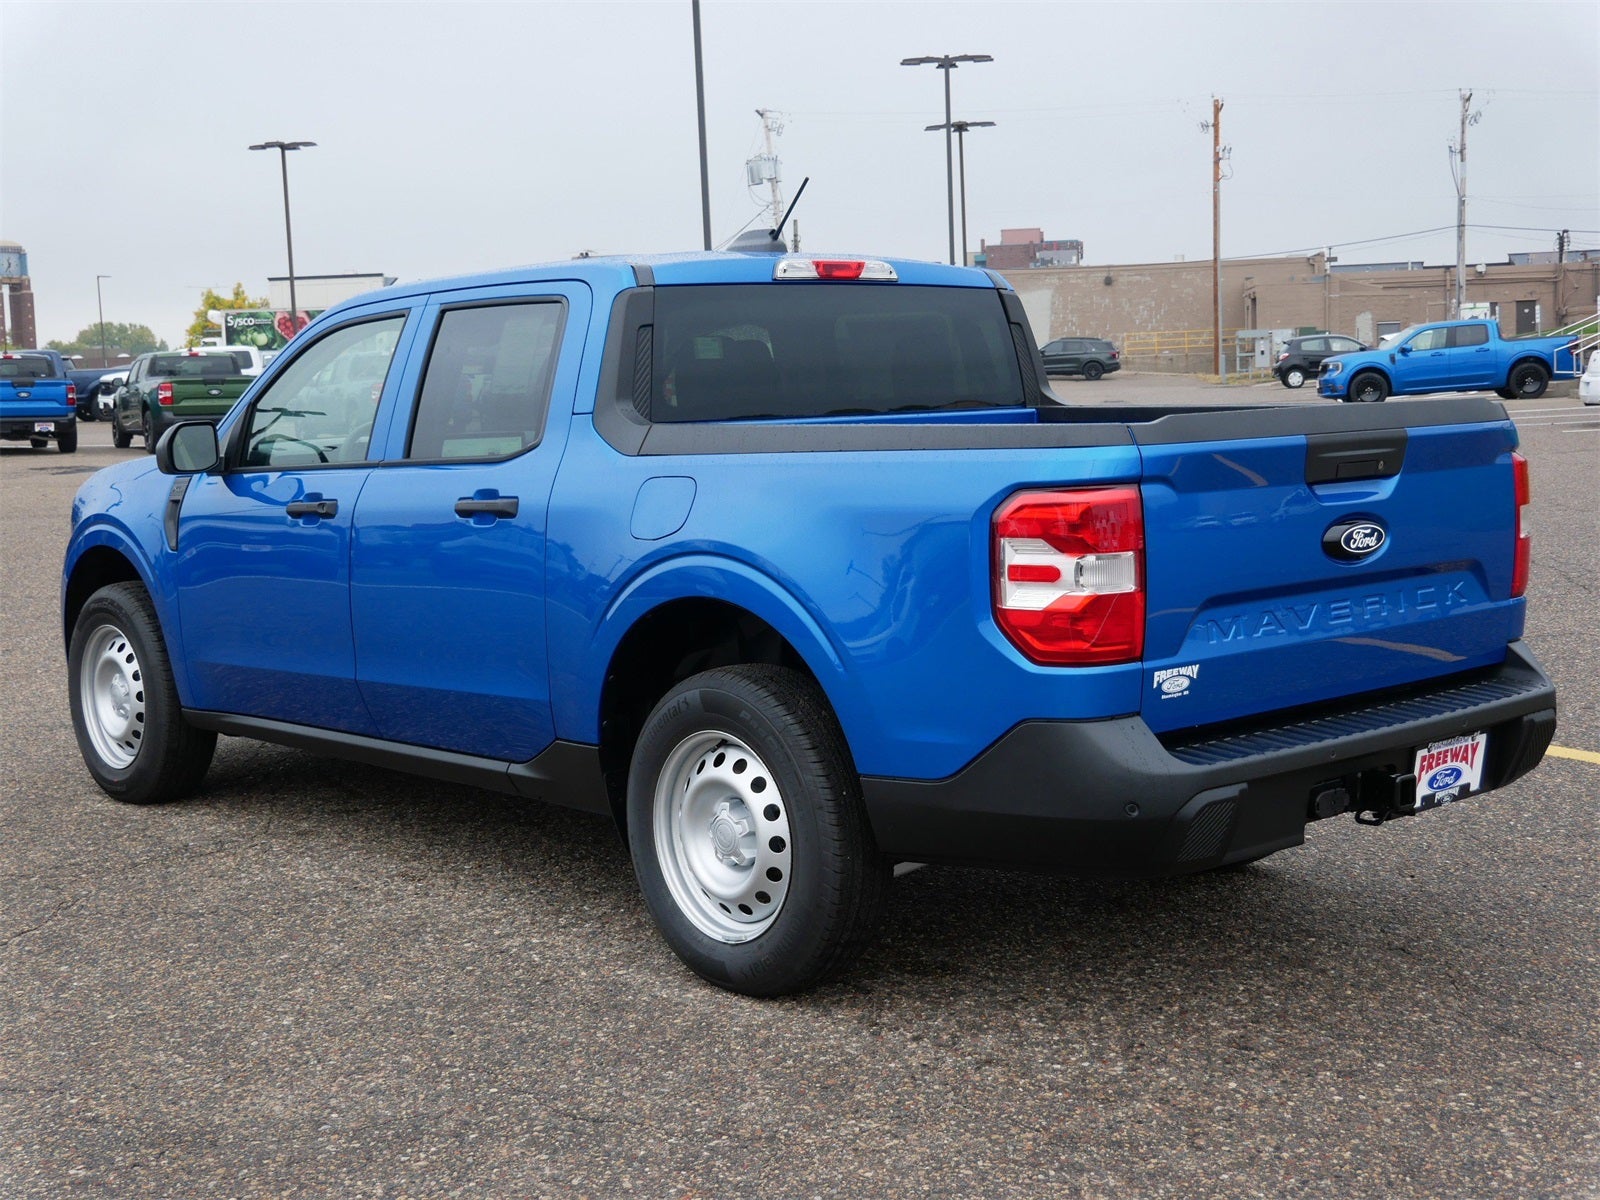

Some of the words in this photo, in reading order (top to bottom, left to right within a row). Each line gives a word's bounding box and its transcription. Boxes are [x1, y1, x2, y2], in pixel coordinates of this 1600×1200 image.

[227, 316, 255, 328] Sysco
[1350, 528, 1378, 548] Ford
[1205, 581, 1468, 645] MAVERICK
[1153, 664, 1200, 689] FREEWAY
[1416, 741, 1480, 785] FREEWAY
[1433, 769, 1457, 788] Ford
